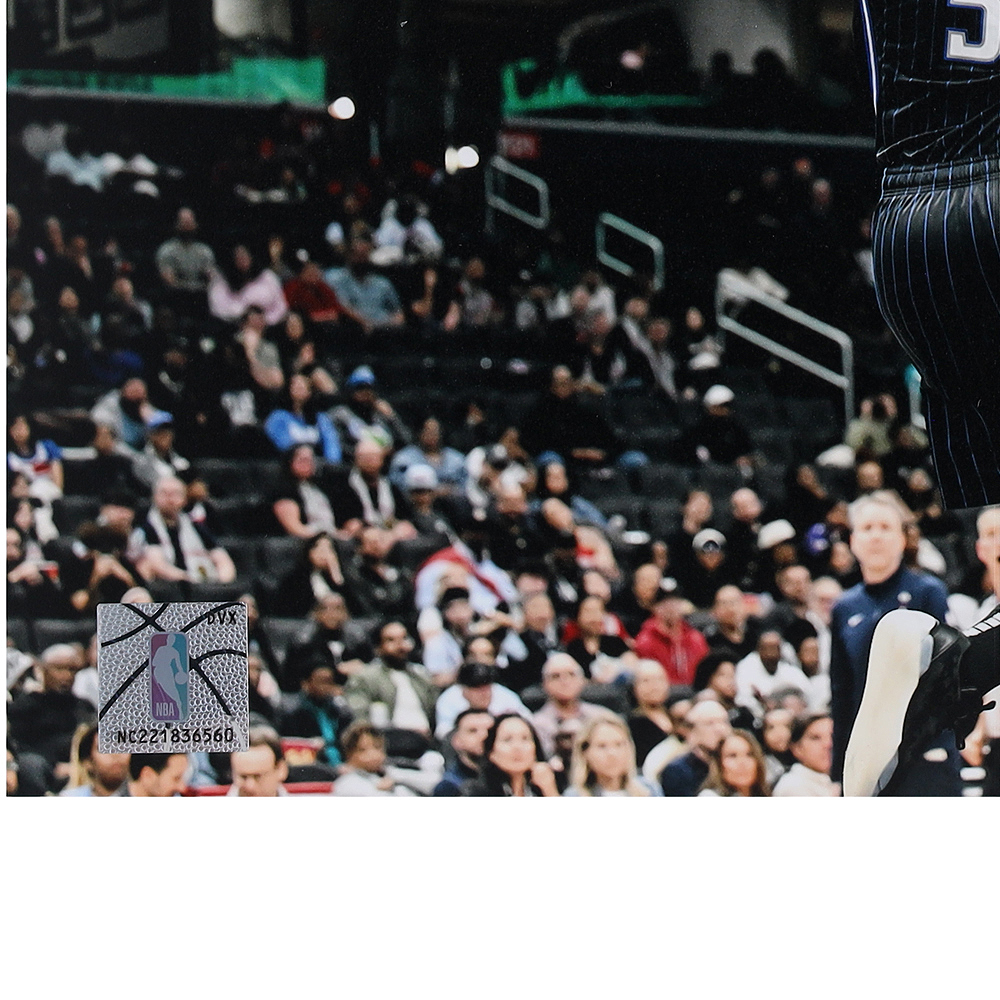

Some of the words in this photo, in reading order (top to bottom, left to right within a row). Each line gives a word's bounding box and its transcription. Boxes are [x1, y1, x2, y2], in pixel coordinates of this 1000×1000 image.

[207, 610, 237, 625] DVX
[155, 701, 176, 717] NBA
[117, 727, 234, 744] NC221836560
